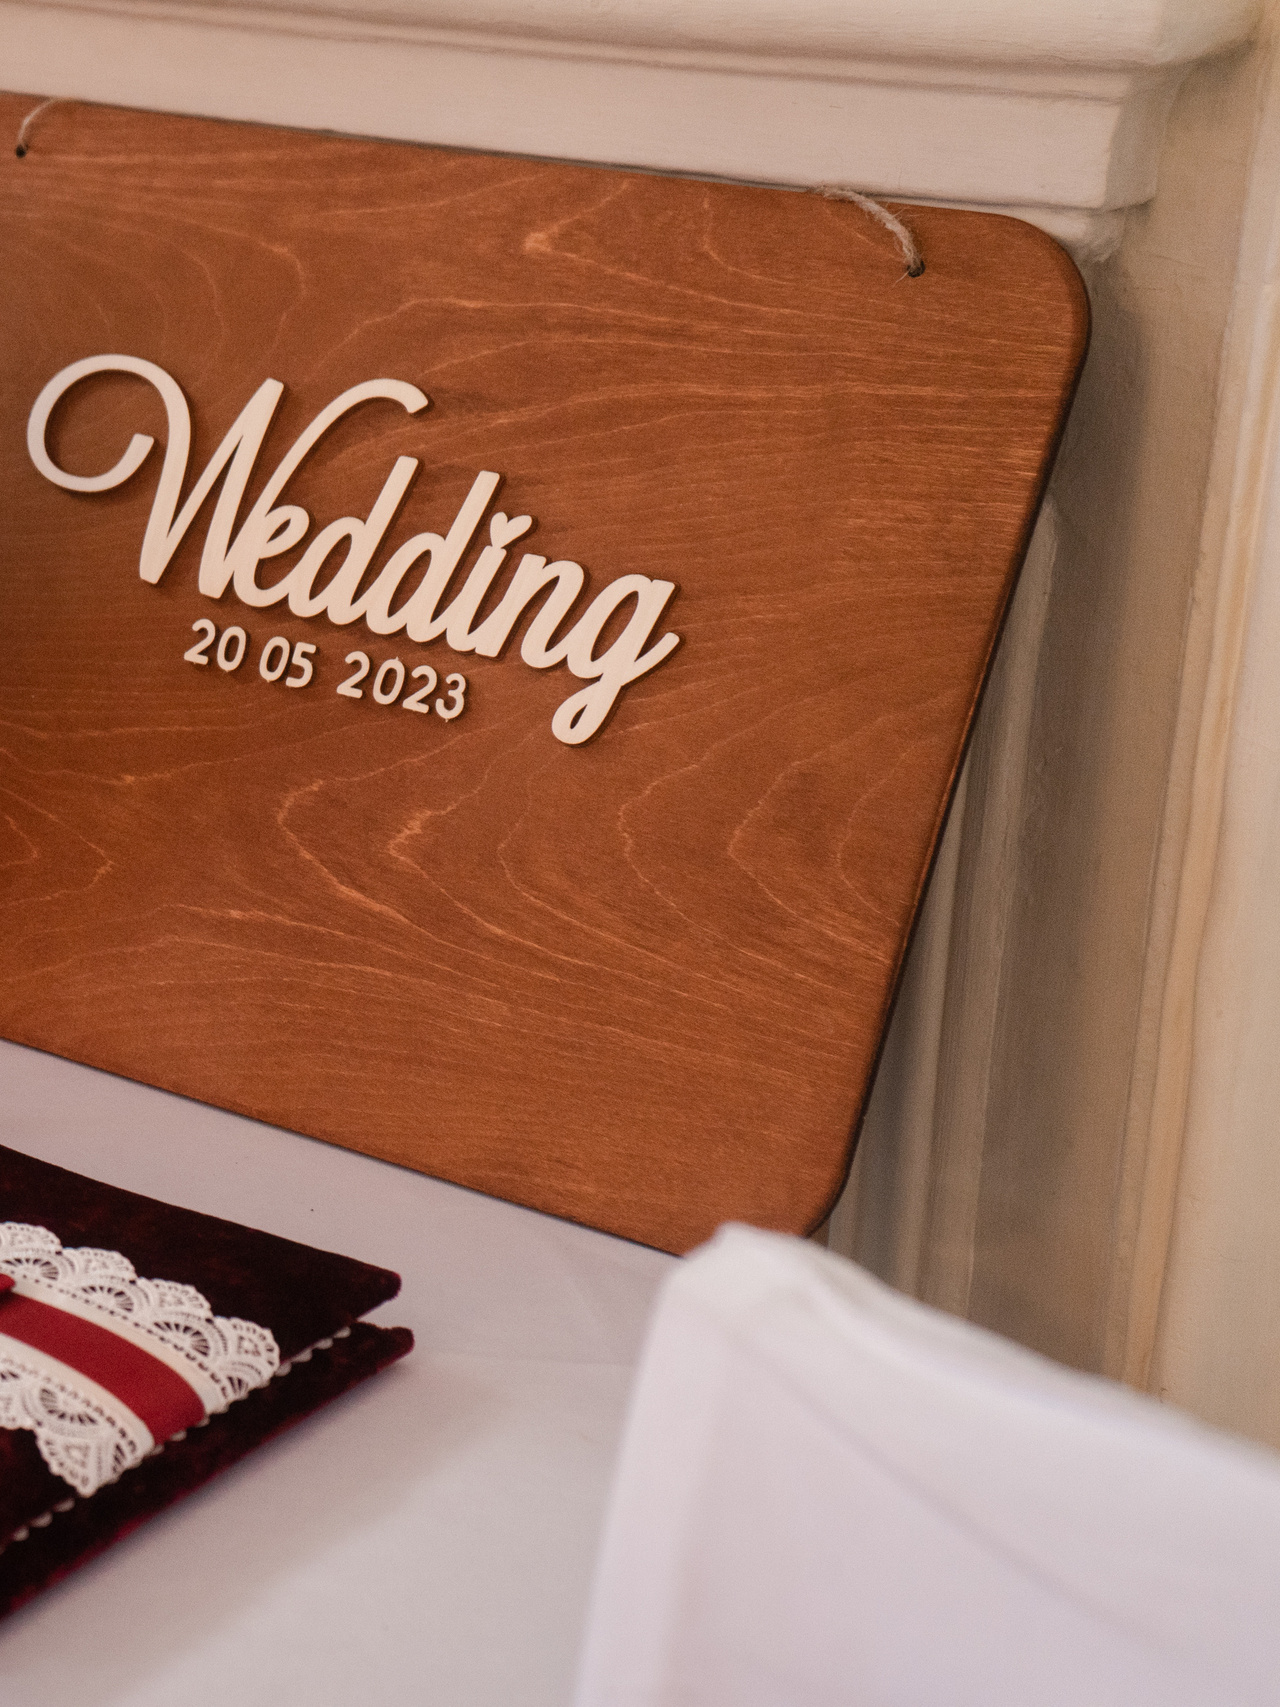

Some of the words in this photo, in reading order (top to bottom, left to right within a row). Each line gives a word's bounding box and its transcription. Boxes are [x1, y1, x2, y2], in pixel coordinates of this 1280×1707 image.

[26, 353, 680, 745] Wedding
[184, 618, 247, 672] 20
[259, 636, 317, 688] 05
[336, 650, 467, 721] 2023
